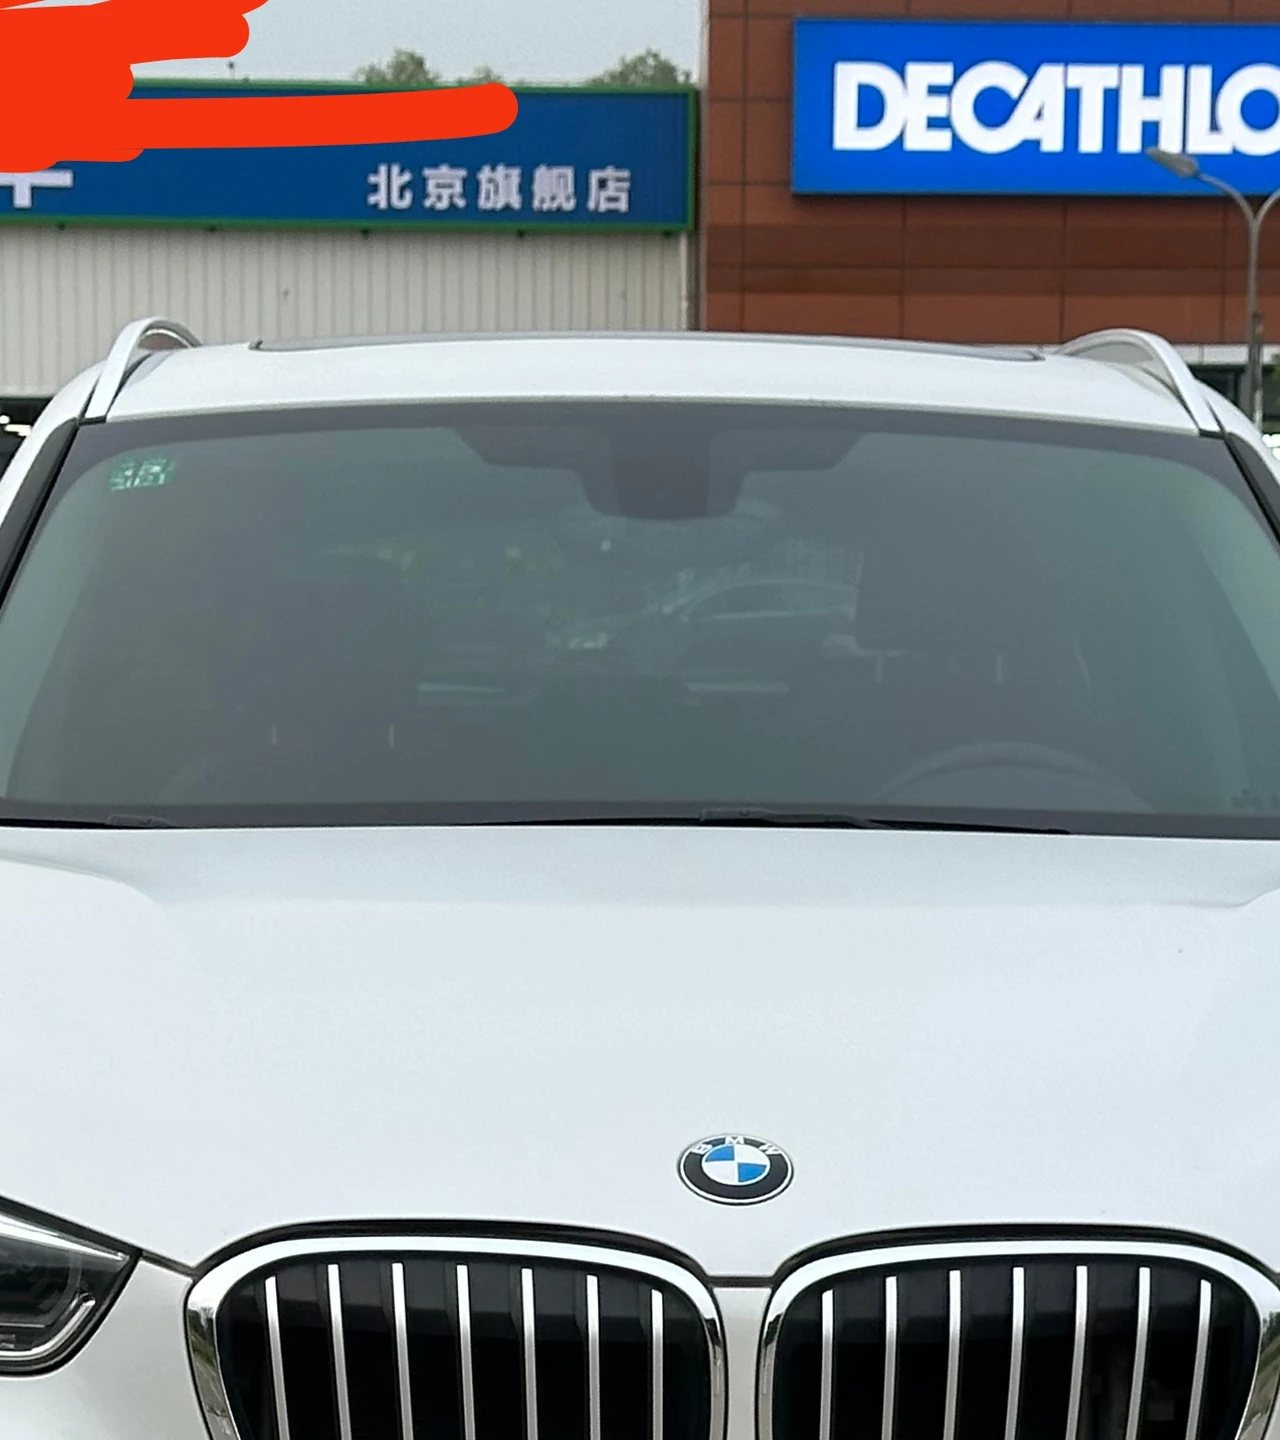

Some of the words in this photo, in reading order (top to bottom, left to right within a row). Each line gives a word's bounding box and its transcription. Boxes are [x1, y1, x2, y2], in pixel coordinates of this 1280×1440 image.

[366, 162, 632, 213] 北京旗舰店
